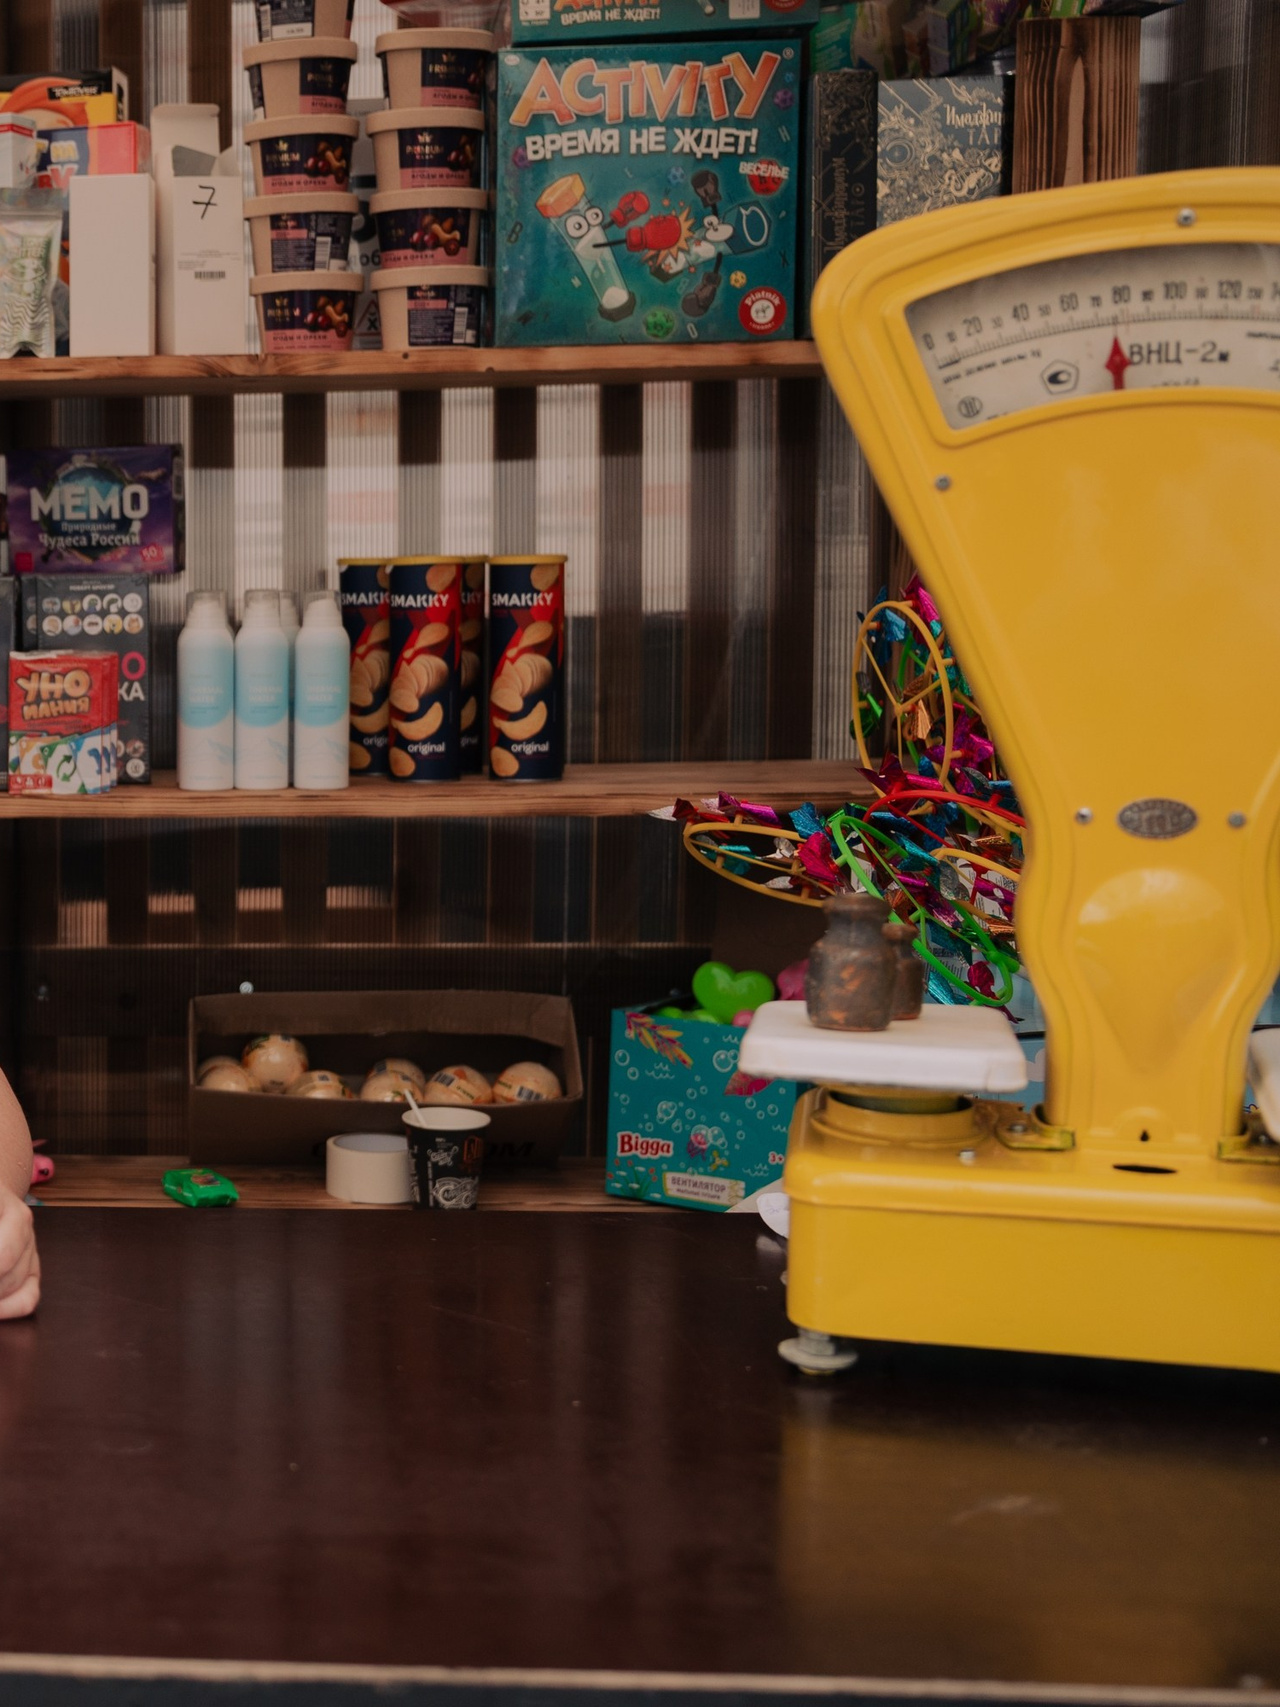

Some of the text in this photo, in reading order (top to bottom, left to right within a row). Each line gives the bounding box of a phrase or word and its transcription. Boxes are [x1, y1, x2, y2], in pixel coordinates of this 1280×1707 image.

[560, 9, 602, 26] ВРЕМЯ
[605, 8, 622, 21] НЕ
[623, 8, 660, 22] ЖДЕТ!
[509, 51, 781, 127] ACTIVITY
[525, 126, 759, 162] ВРЕМЯ НЕ ЖДЕТ!
[738, 160, 791, 179] ВЕСЕЛЬЕ
[192, 184, 218, 220] 7
[963, 317, 983, 336] 20
[1012, 303, 1030, 322] 40
[1060, 293, 1079, 312] 60
[1112, 285, 1131, 304] 80
[1163, 281, 1188, 300] 100
[1218, 280, 1242, 299] 120
[29, 483, 149, 522] МЕМО
[61, 522, 116, 532] Природные
[38, 532, 140, 549] Чудеса России
[341, 592, 390, 606] SMAKK
[391, 593, 450, 607] SMAKKY
[492, 592, 554, 606] SMAKKY
[16, 669, 91, 703] УНО
[407, 741, 446, 756] original
[511, 741, 549, 756] original
[618, 1132, 673, 1158] Bigga
[671, 1175, 726, 1194] ВЕНТИЛЯТОР
